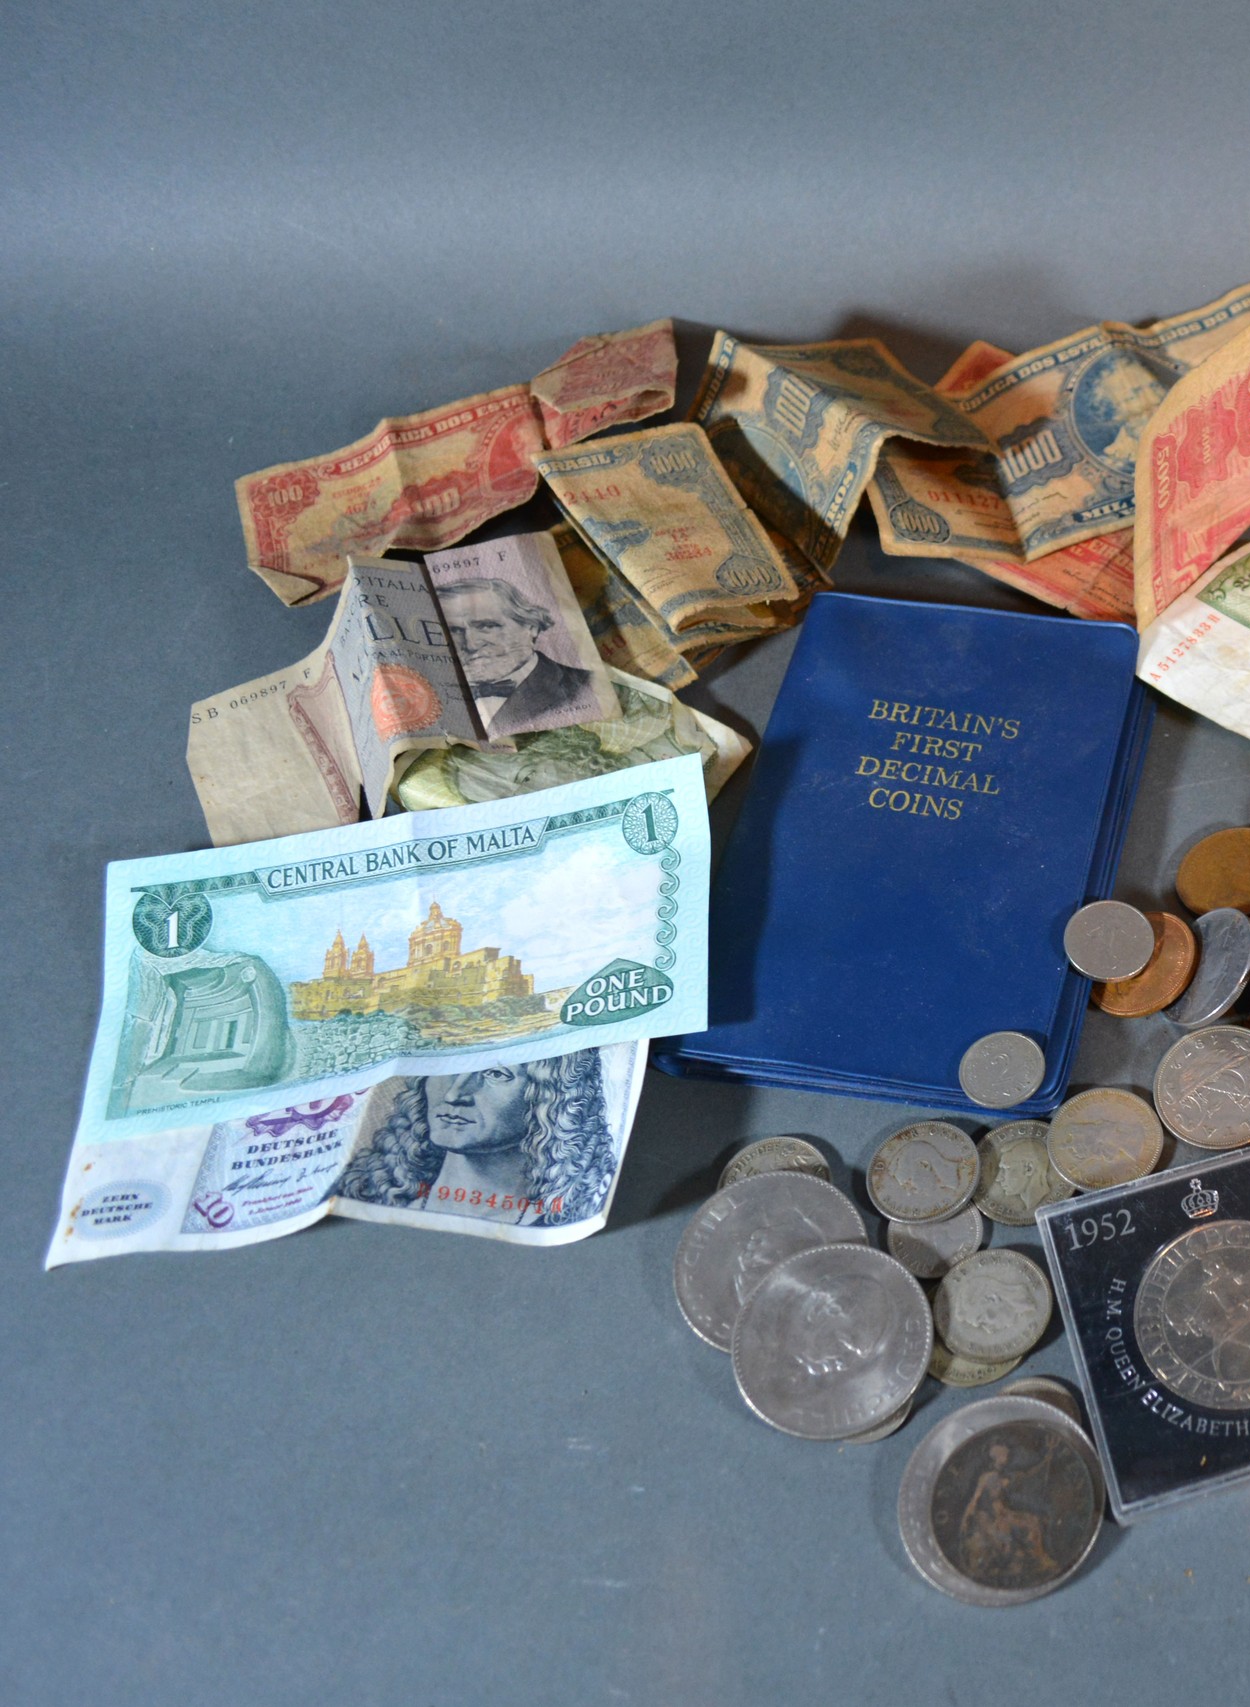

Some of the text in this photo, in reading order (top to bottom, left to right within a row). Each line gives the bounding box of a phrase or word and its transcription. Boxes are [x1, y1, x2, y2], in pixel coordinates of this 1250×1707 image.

[435, 411, 473, 435] DOS
[268, 483, 304, 506] 100
[1156, 446, 1171, 510] 5000
[432, 557, 482, 575] 69897
[229, 680, 288, 710] 069897
[302, 667, 311, 679] F
[867, 698, 1022, 740] BRITAIN'S
[890, 731, 983, 763] FIRST
[854, 755, 1001, 795] DECIMAL
[868, 787, 964, 821] COINS
[639, 801, 663, 843] 1
[267, 825, 537, 889] CENTRAL BANK OF MALTA
[163, 909, 181, 950] 1
[585, 968, 647, 999] ONE
[565, 985, 674, 1023] POUND
[136, 1096, 221, 1117] PREHISTORIC TEMPLE
[230, 1138, 345, 1171] BUNDESBANK
[246, 1128, 339, 1155] DEUTSCHE
[81, 1201, 154, 1218] DEUTSCHE
[101, 1192, 142, 1204] ZEHN
[93, 1213, 133, 1226] MARK
[1065, 1208, 1137, 1252] 1952
[1104, 1325, 1147, 1392] QUEEN
[1140, 1388, 1249, 1438] ELIZABETH
